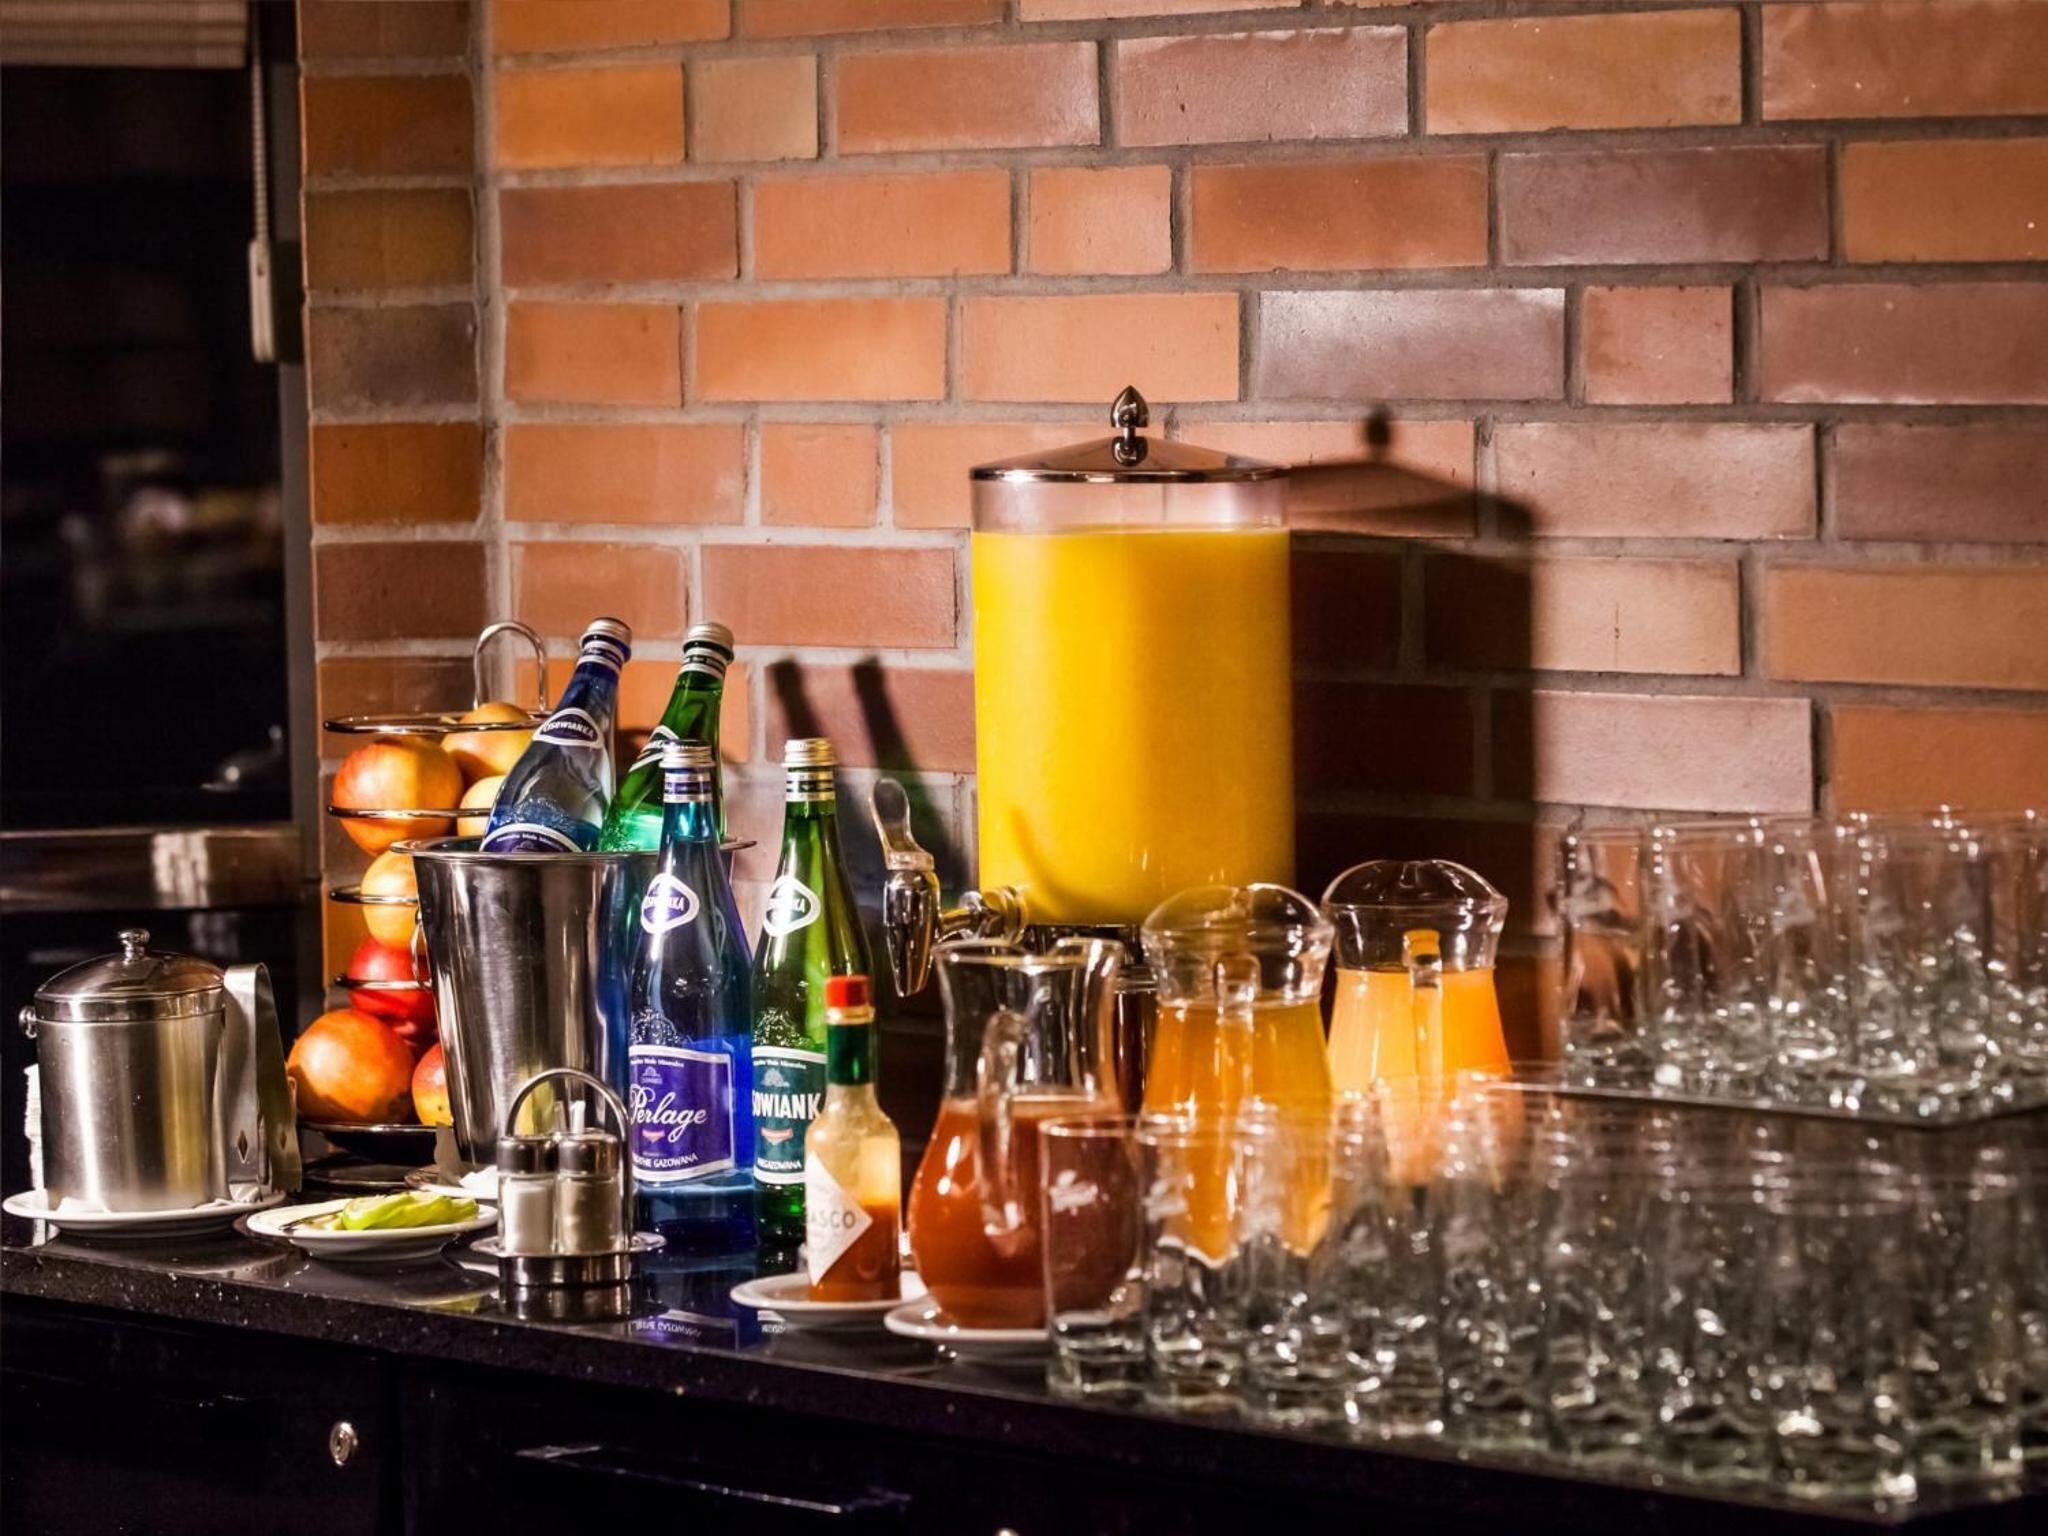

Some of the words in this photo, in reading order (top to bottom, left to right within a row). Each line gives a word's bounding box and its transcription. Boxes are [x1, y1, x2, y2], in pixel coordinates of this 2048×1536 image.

[630, 1083, 708, 1143] Perlage
[752, 1089, 822, 1120] OWIANK
[809, 1210, 856, 1229] ASCO
